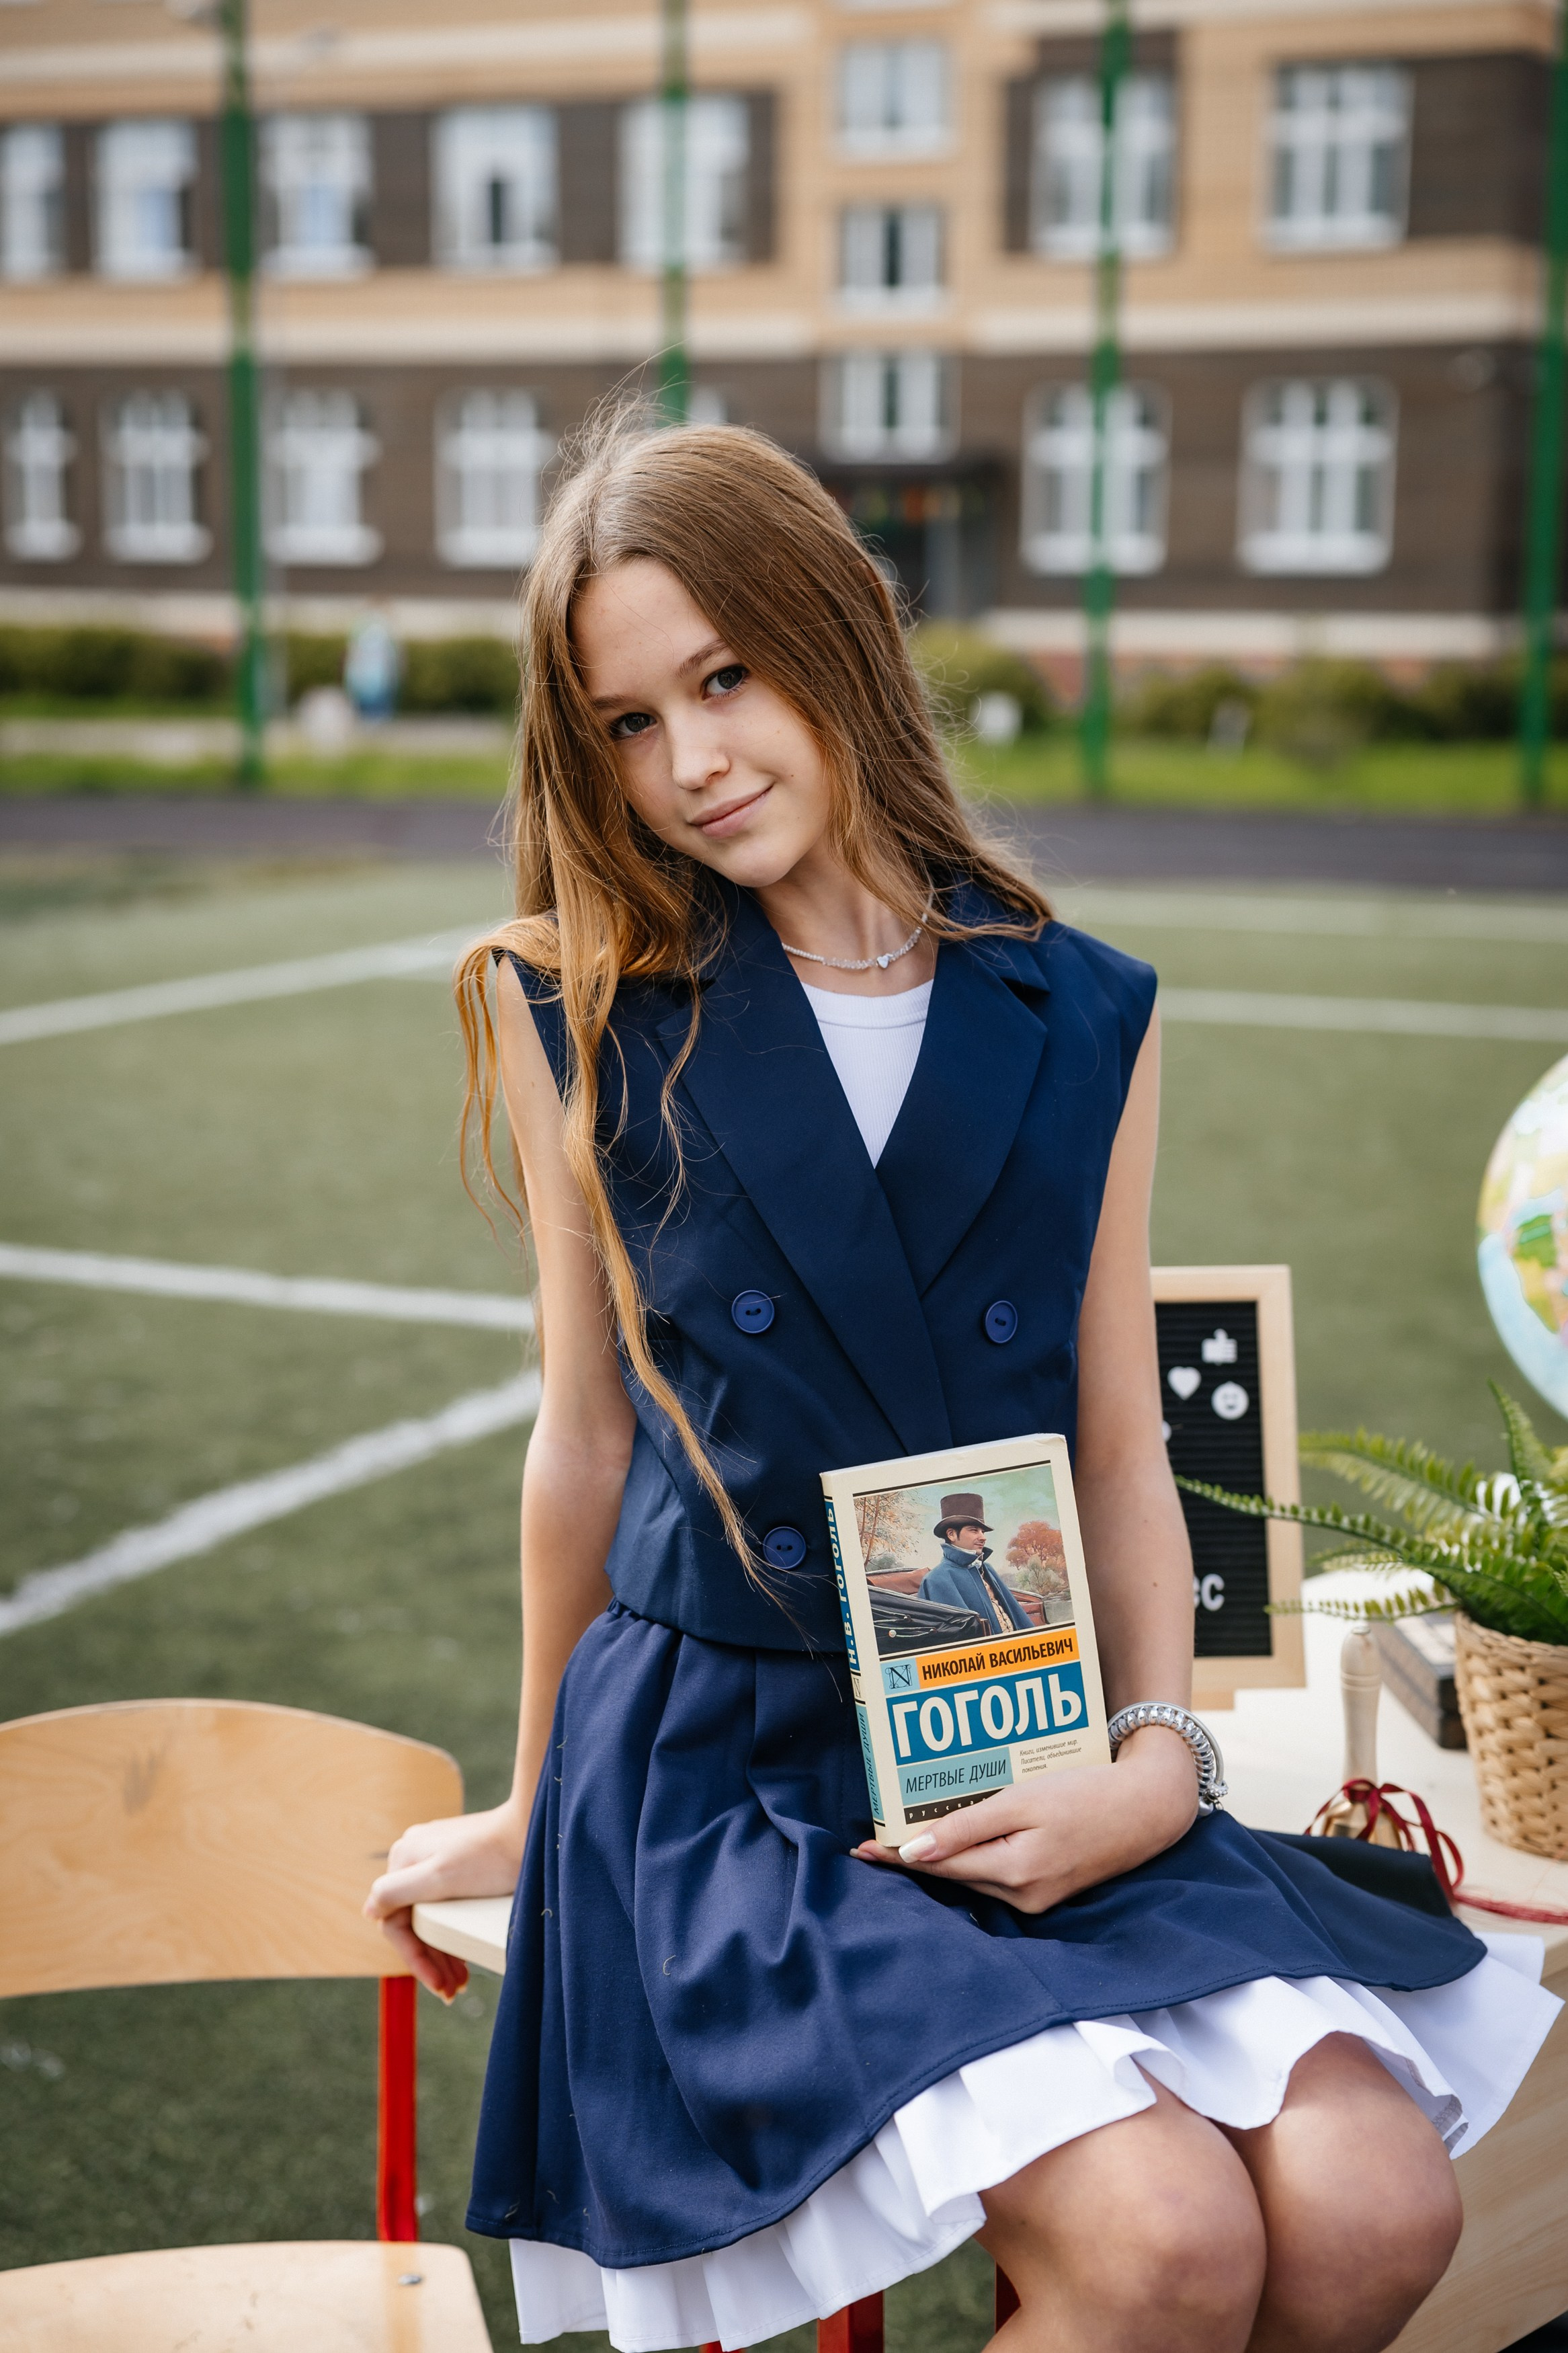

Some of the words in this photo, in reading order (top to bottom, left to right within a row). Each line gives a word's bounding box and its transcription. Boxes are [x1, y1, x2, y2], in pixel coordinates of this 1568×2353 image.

[827, 1507, 847, 1603] ГОГОЛЬ
[921, 1652, 986, 1680] НИКОЛАЙ
[989, 1638, 1074, 1668] ВАСИЛЬЕВИЧ
[859, 1712, 871, 1753] ДУШИ
[892, 1673, 1082, 1758] ГОГОЛЬ
[1021, 1755, 1045, 1764] Писатели,
[1047, 1747, 1081, 1759] объединившие
[1022, 1764, 1048, 1773] поколения.
[1036, 1743, 1066, 1753] изменившие
[866, 1755, 880, 1815] МЕРТВЫЕ
[906, 1767, 965, 1794] МЕРТВЫЕ
[968, 1759, 1006, 1784] ДУШИ
